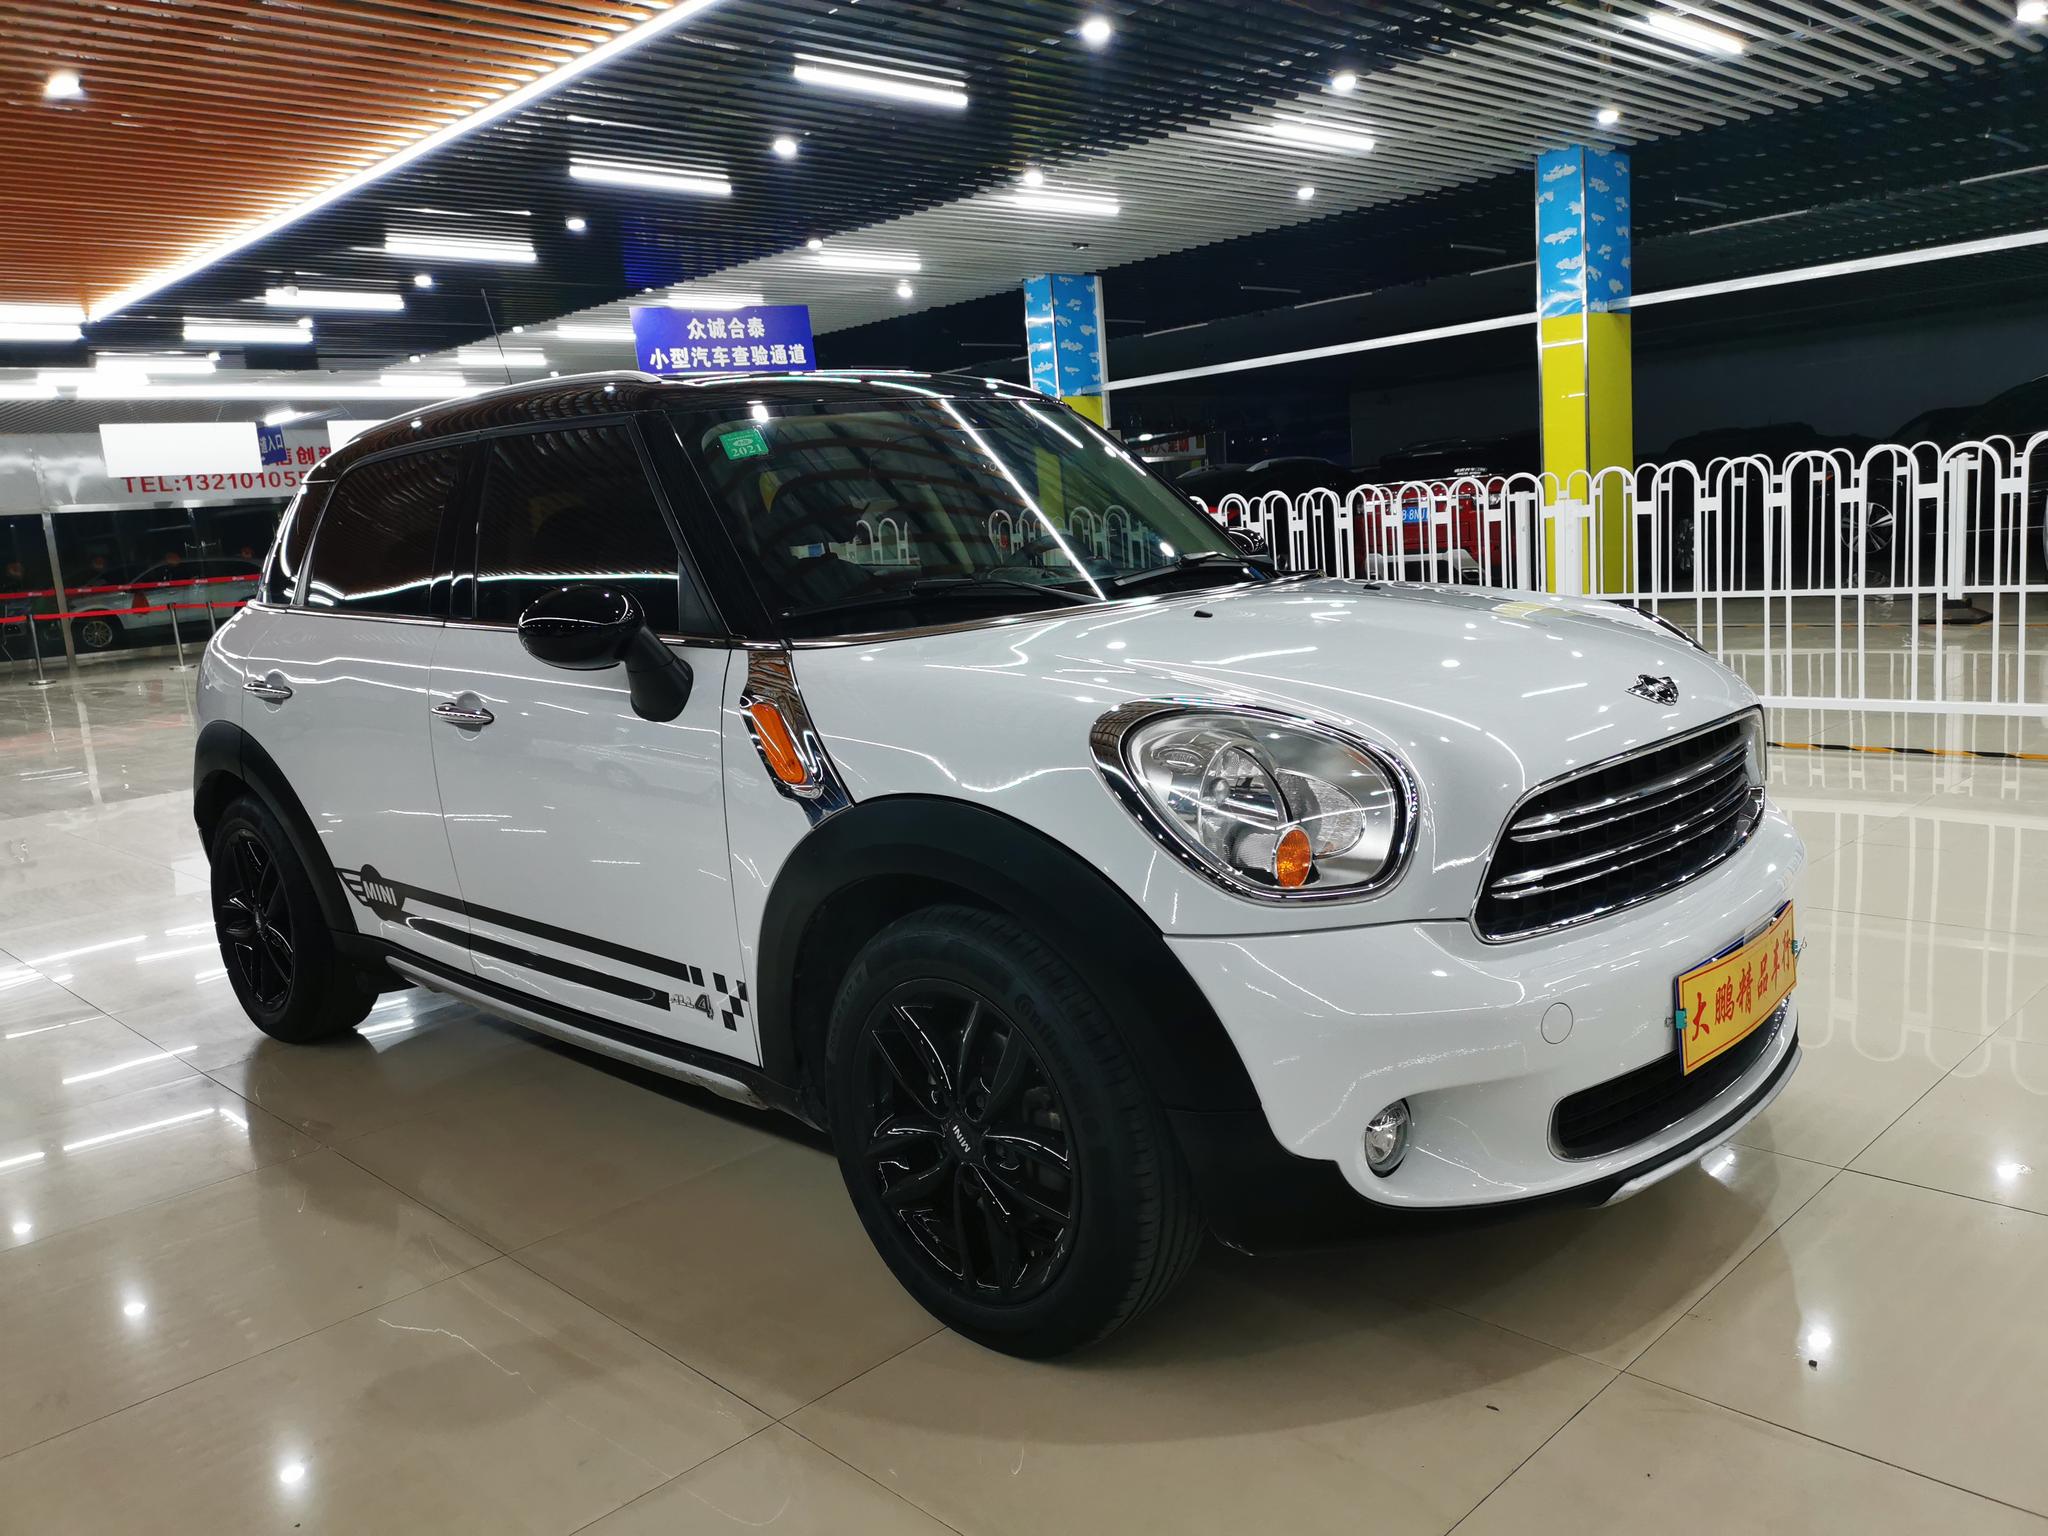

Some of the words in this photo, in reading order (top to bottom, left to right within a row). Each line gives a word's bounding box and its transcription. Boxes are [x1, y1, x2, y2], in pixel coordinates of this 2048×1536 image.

[687, 317, 765, 340] 众诚合泰
[650, 343, 806, 370] 小型汽车查验通道
[731, 444, 763, 457] 2021
[362, 881, 397, 907] MINI
[1692, 929, 1791, 1042] 大鹏精品车行
[952, 1124, 971, 1153] MINI
